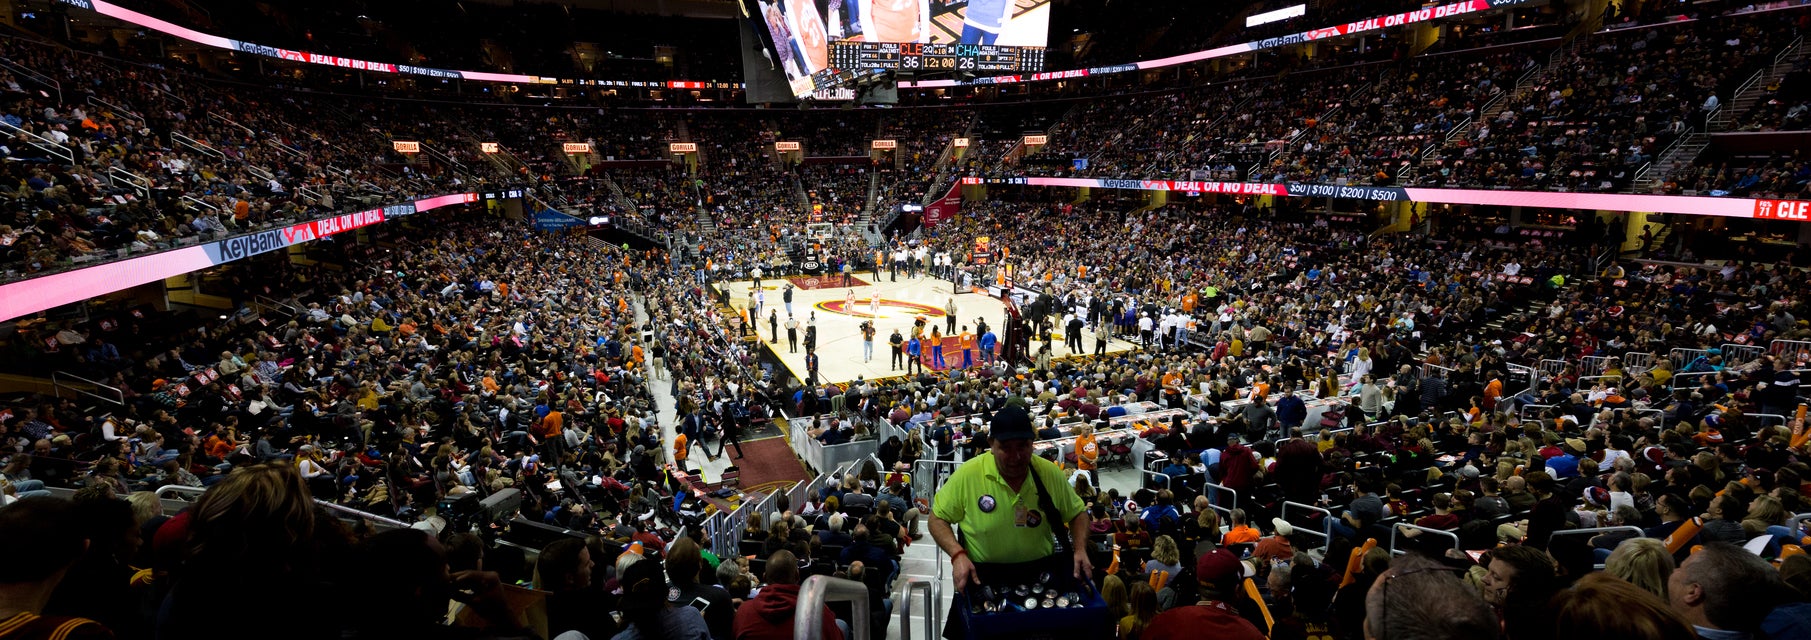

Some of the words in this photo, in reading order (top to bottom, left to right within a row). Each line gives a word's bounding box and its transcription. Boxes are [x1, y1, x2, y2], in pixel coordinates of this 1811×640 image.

[1347, 20, 1381, 34] DEAL
[1384, 15, 1406, 27] OR
[1408, 9, 1430, 23] NO
[1435, 0, 1477, 19] DEAL
[1257, 33, 1306, 51] KeyBank
[239, 41, 278, 57] KeyBank
[900, 43, 923, 56] CLE
[956, 44, 979, 56] CHA
[310, 53, 335, 66] DEAL
[337, 57, 351, 68] OR
[352, 59, 366, 70] NO
[368, 61, 391, 72] DEAL
[903, 56, 919, 68] 36
[924, 57, 955, 68] 12:00
[960, 57, 975, 69] 26
[413, 66, 427, 75] $100
[1040, 70, 1051, 80] OR
[1051, 69, 1063, 79] NO
[1064, 69, 1084, 78] DEAL
[395, 143, 417, 151] GORILLA
[1103, 179, 1142, 189] KeyBank
[1174, 181, 1200, 191] DEAL
[1204, 181, 1220, 192] OR
[1222, 182, 1240, 192] NO
[1243, 183, 1278, 194] DEAL
[1290, 184, 1306, 193] $50
[1312, 185, 1334, 196] $100
[1340, 186, 1364, 199] $200
[1371, 189, 1397, 201] $500
[1760, 207, 1771, 216] 71
[1777, 201, 1809, 219] CLE
[317, 219, 340, 235] DEAL
[340, 216, 353, 230] OR
[353, 213, 364, 227] NO
[364, 208, 381, 225] DEAL
[219, 228, 284, 261] KeyBank
